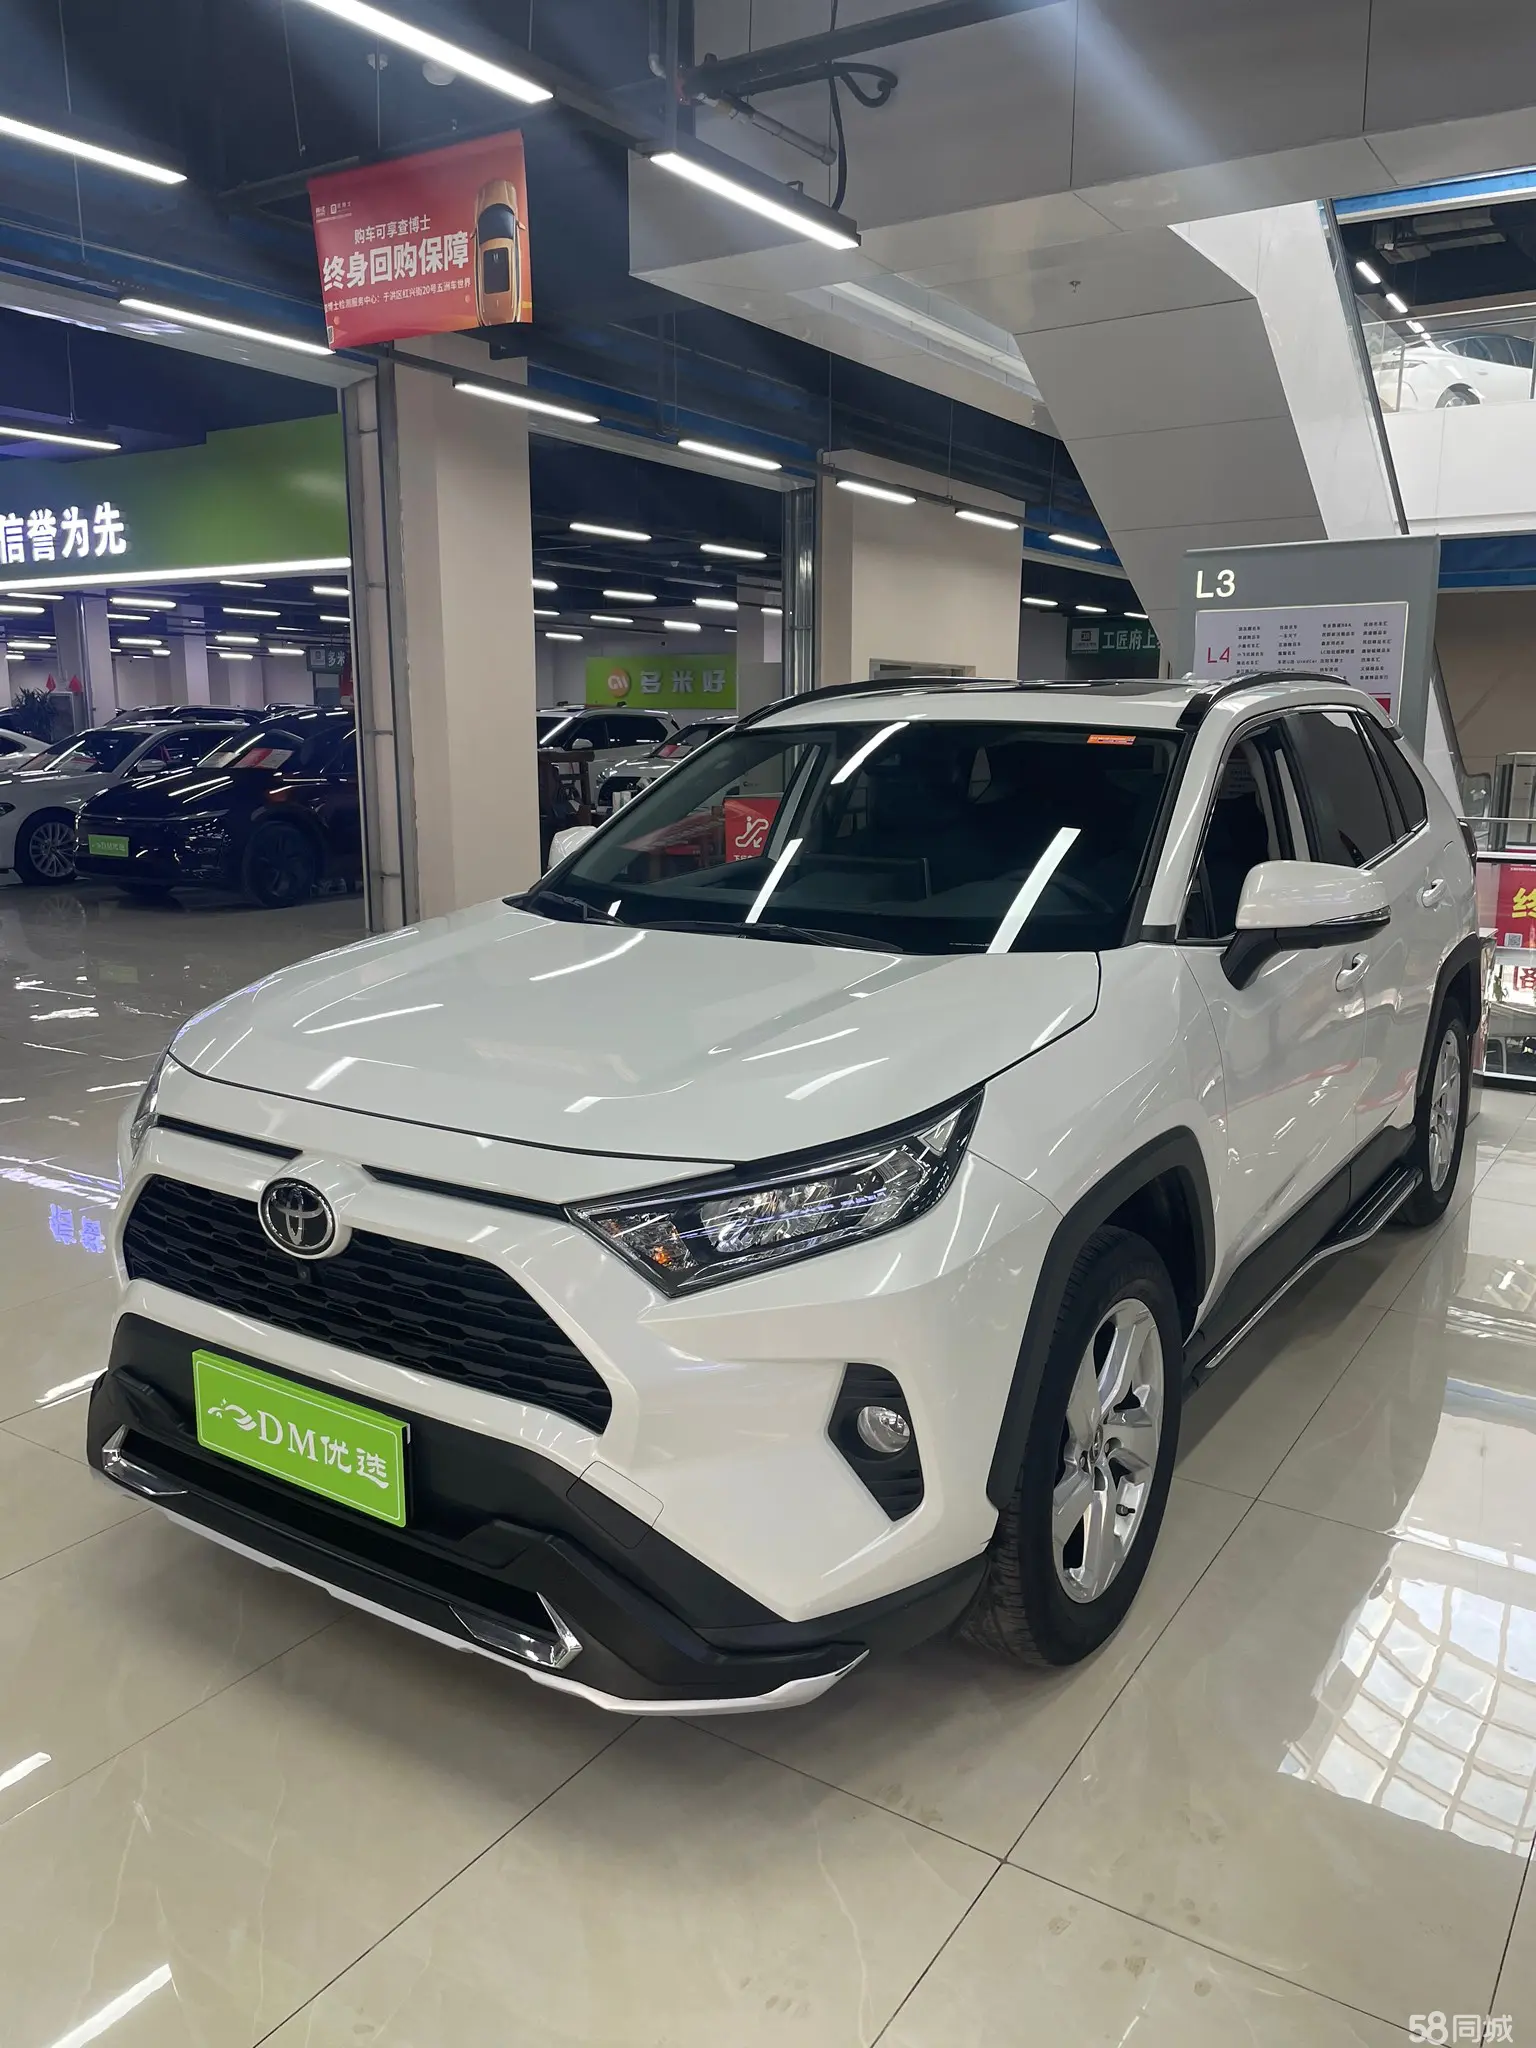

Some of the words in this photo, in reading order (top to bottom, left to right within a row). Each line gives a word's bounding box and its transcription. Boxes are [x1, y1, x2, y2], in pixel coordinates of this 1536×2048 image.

[355, 214, 431, 245] 购车可享查博士
[323, 231, 469, 292] 终身回购保障
[0, 501, 127, 564] 信誉为先
[1196, 569, 1236, 599] L3
[1102, 628, 1160, 650] 工匠府上
[1207, 647, 1232, 663] L4
[640, 669, 726, 694] 多米好
[257, 1409, 390, 1490] DM优选
